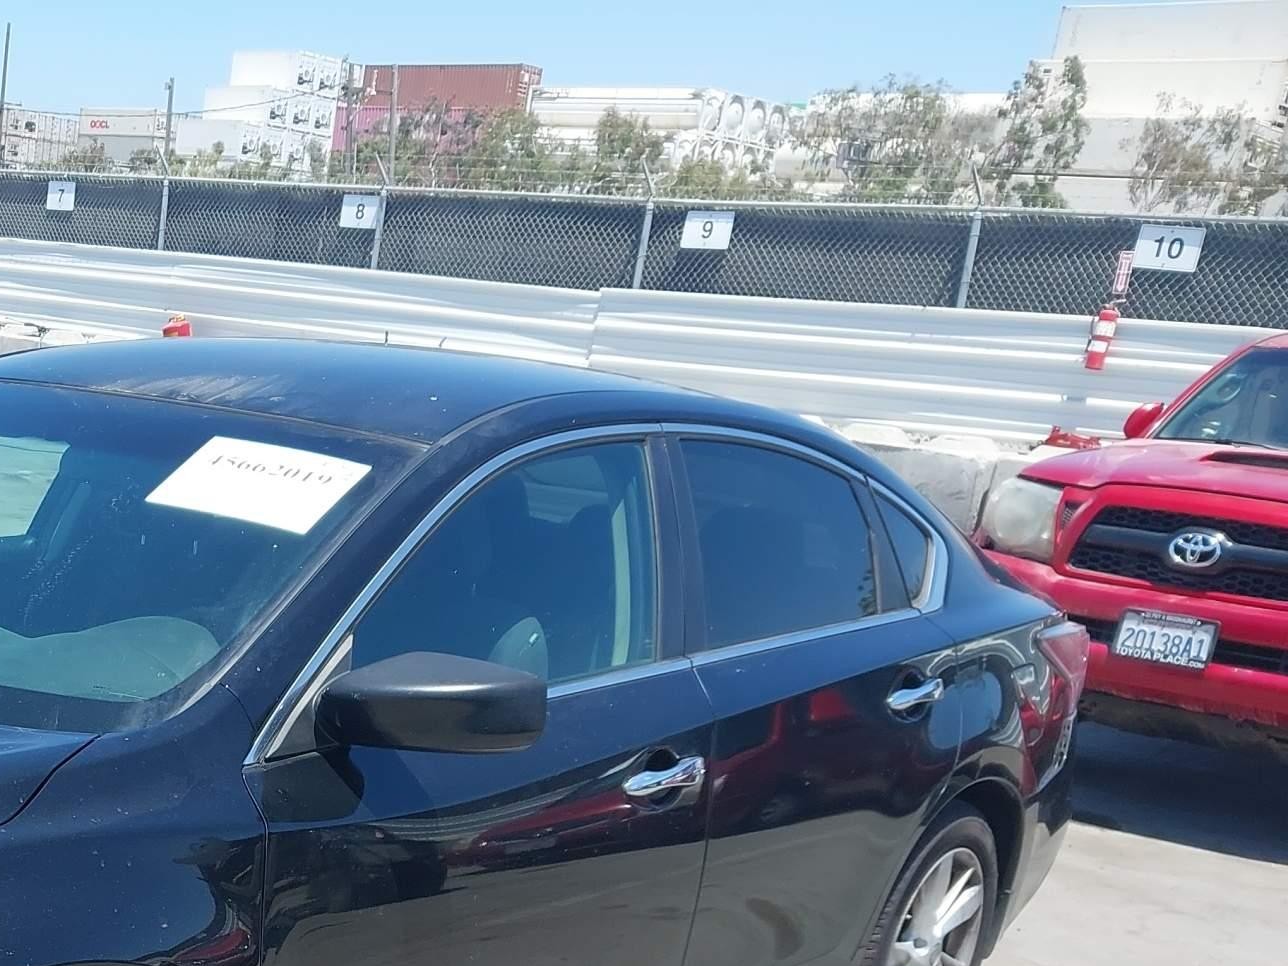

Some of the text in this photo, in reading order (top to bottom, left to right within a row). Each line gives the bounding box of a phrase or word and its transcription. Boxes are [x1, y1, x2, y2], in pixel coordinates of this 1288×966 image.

[89, 120, 109, 129] OOCL
[58, 188, 65, 202] 7
[355, 203, 365, 220] 8
[701, 220, 714, 239] 9
[1154, 235, 1185, 259] 10
[1120, 627, 1207, 660] 20138A1
[1115, 646, 1153, 661] TOYOTA
